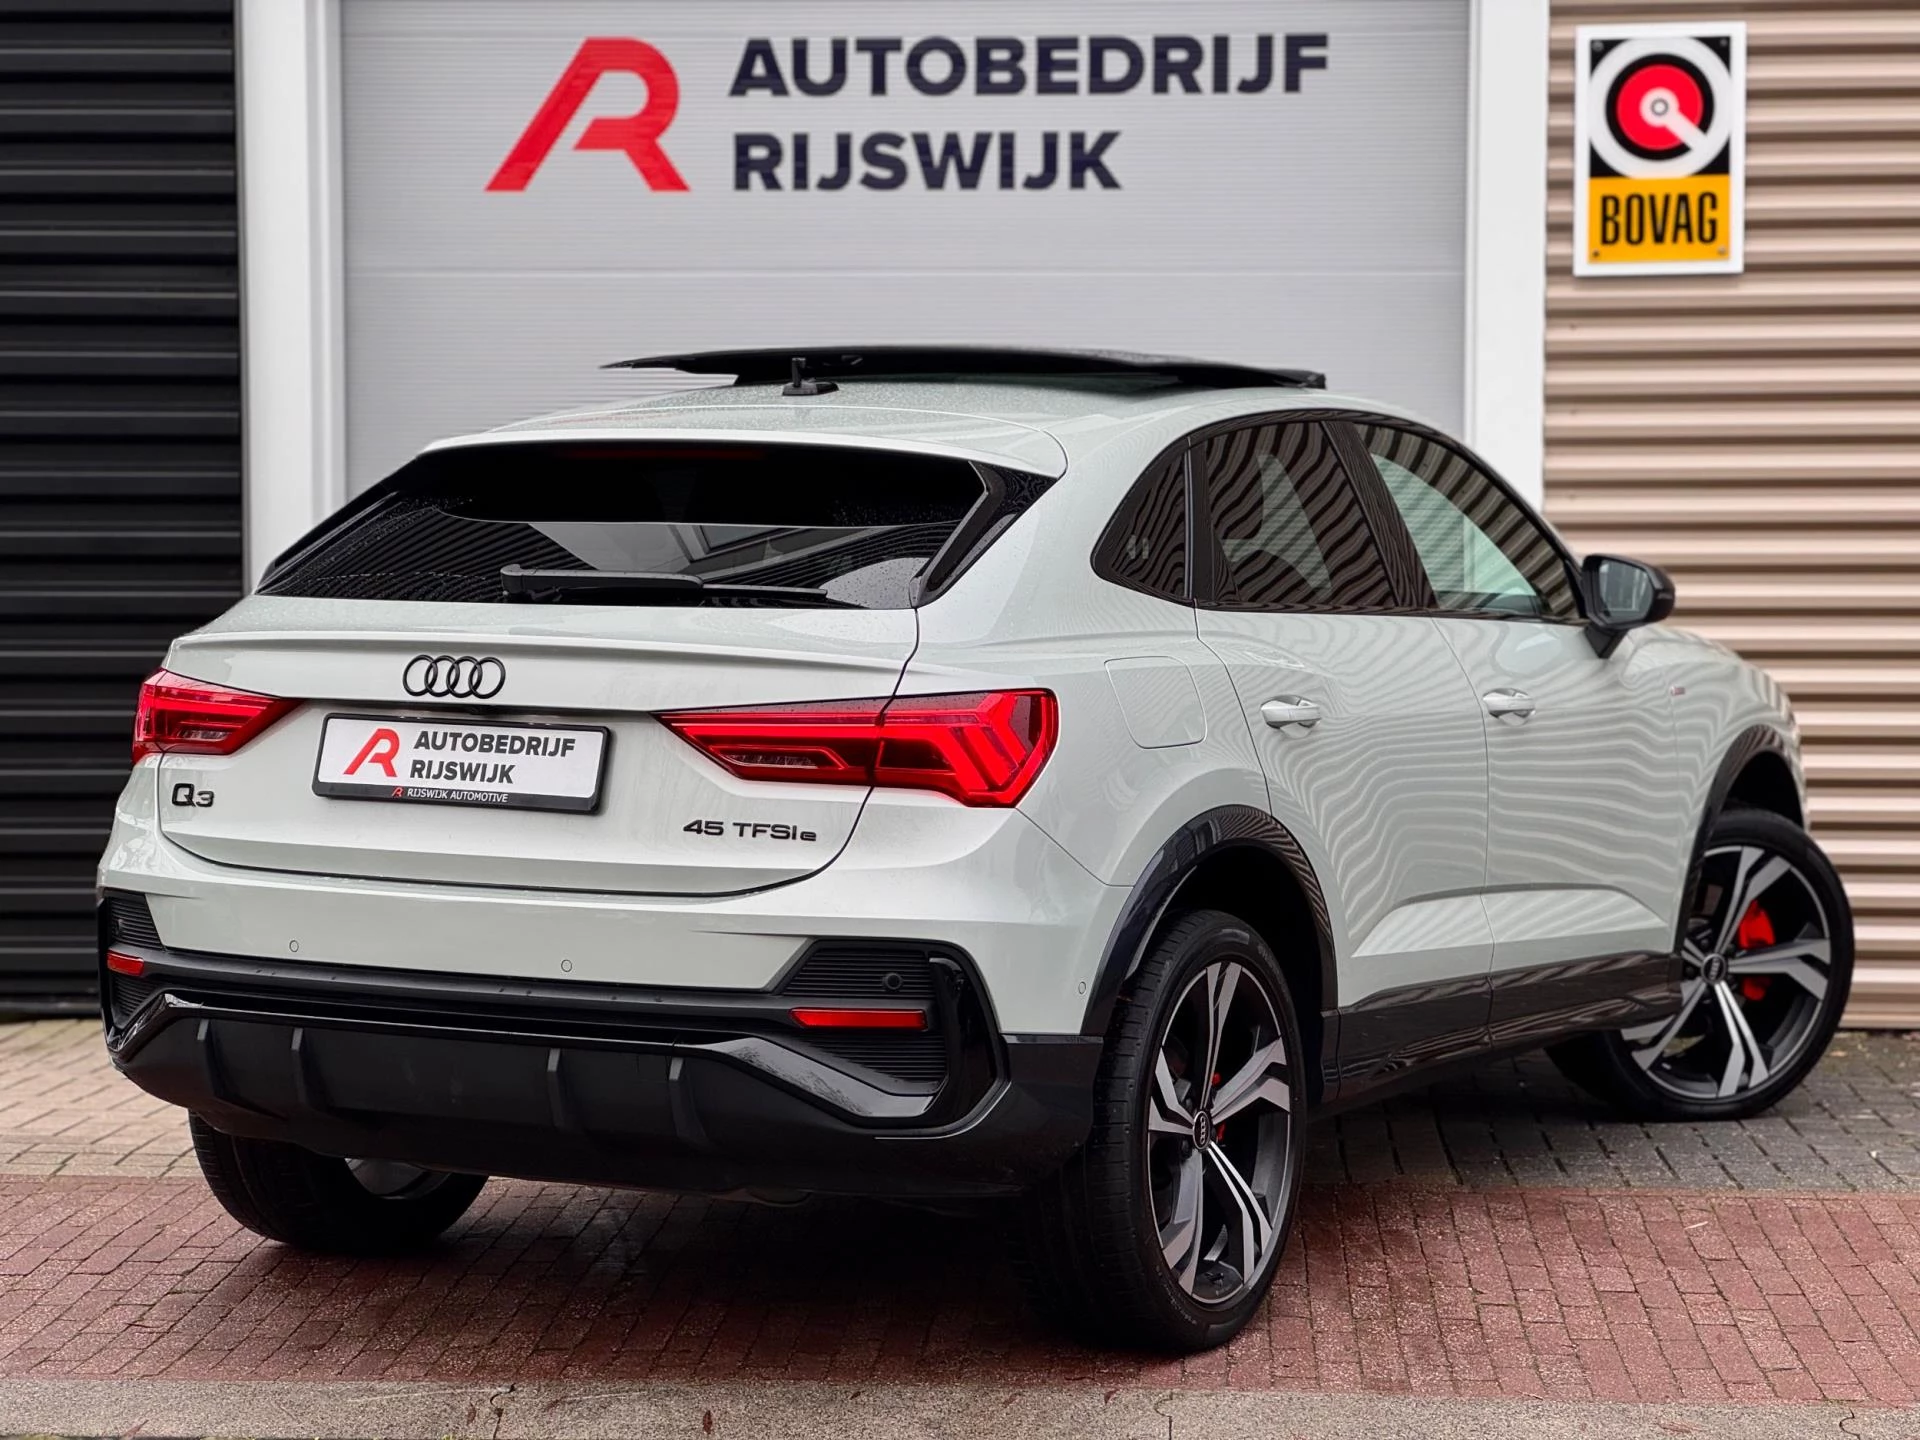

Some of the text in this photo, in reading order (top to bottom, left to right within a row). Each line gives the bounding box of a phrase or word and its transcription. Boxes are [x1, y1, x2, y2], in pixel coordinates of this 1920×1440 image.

[728, 33, 1330, 98] AUTOBEDRIJF
[732, 130, 1123, 192] RIJSWIJK
[1600, 191, 1719, 246] BOVAG
[413, 730, 576, 758] AUTOBEDRIJF
[410, 760, 516, 784] RIJSWIJK
[171, 783, 215, 808] Q3
[407, 787, 449, 799] RIJSWIJK
[450, 790, 509, 803] AUTOMOTIVE
[683, 819, 724, 836] 45
